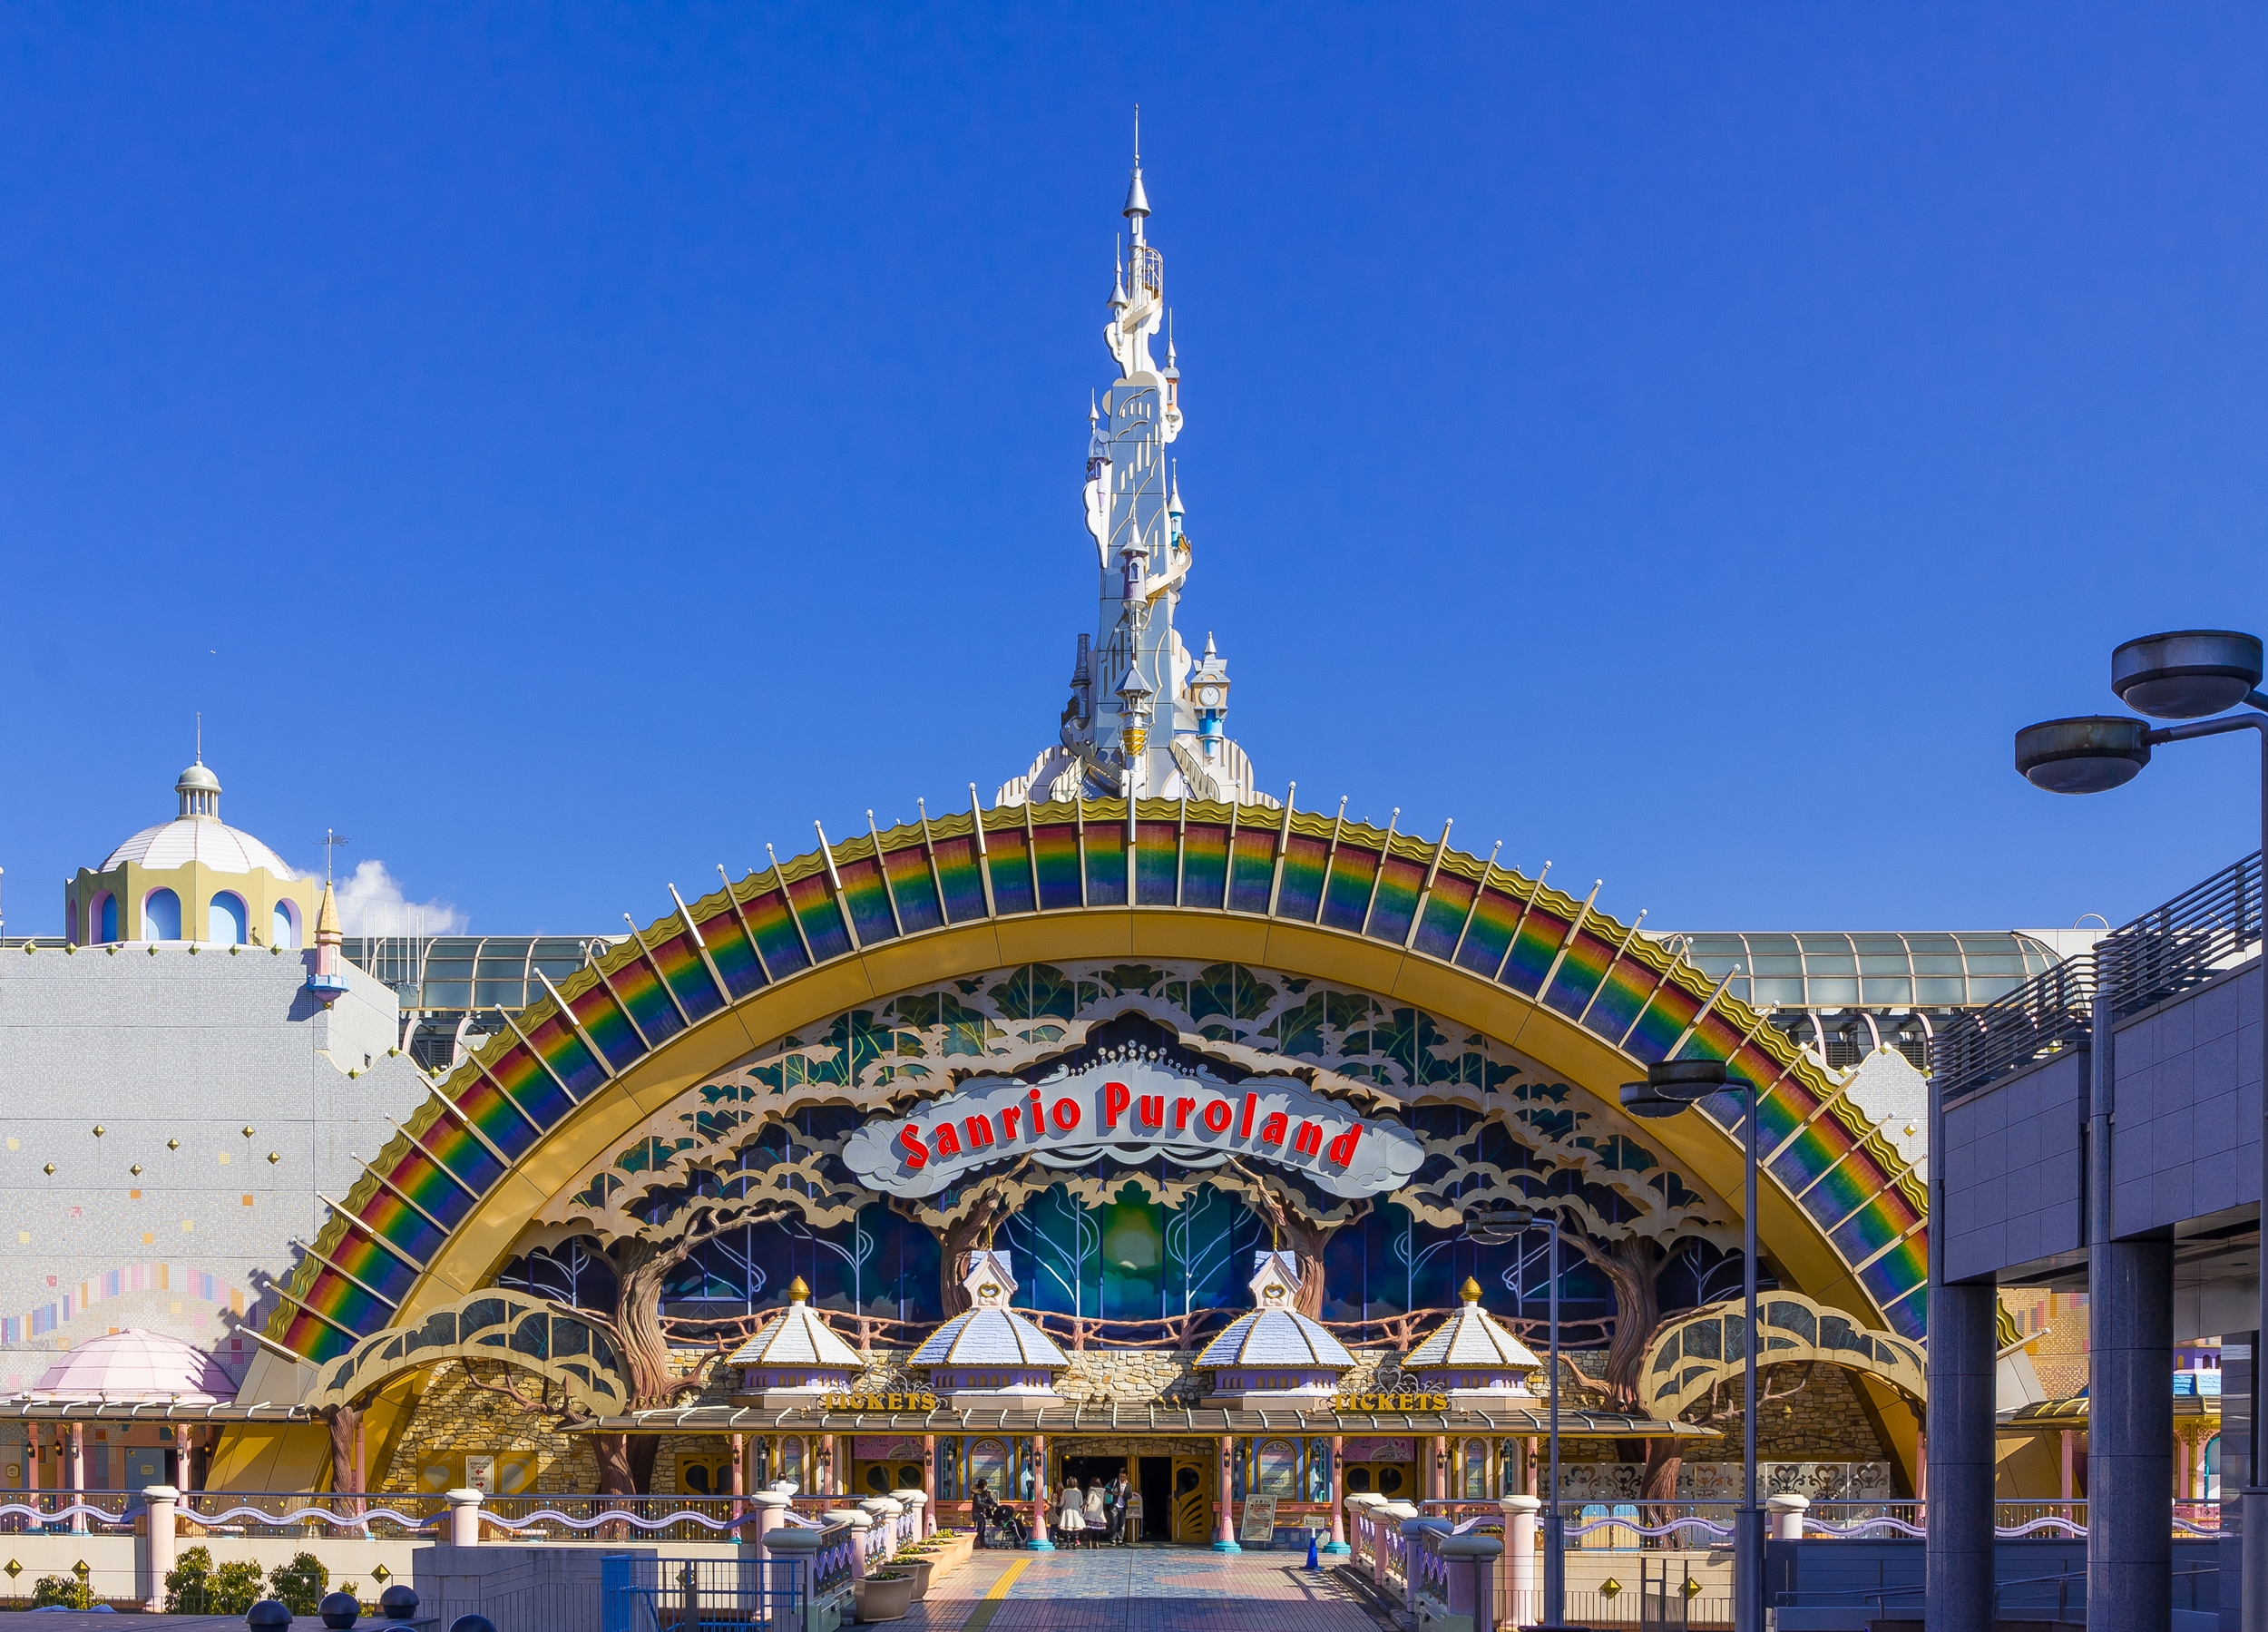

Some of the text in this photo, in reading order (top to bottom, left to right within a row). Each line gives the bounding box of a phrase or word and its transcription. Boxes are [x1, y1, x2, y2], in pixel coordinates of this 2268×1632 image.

[899, 1082, 1364, 1168] Sanrio Puroland
[822, 1393, 936, 1411] TICKETS
[1332, 1393, 1448, 1411] TICKETS
